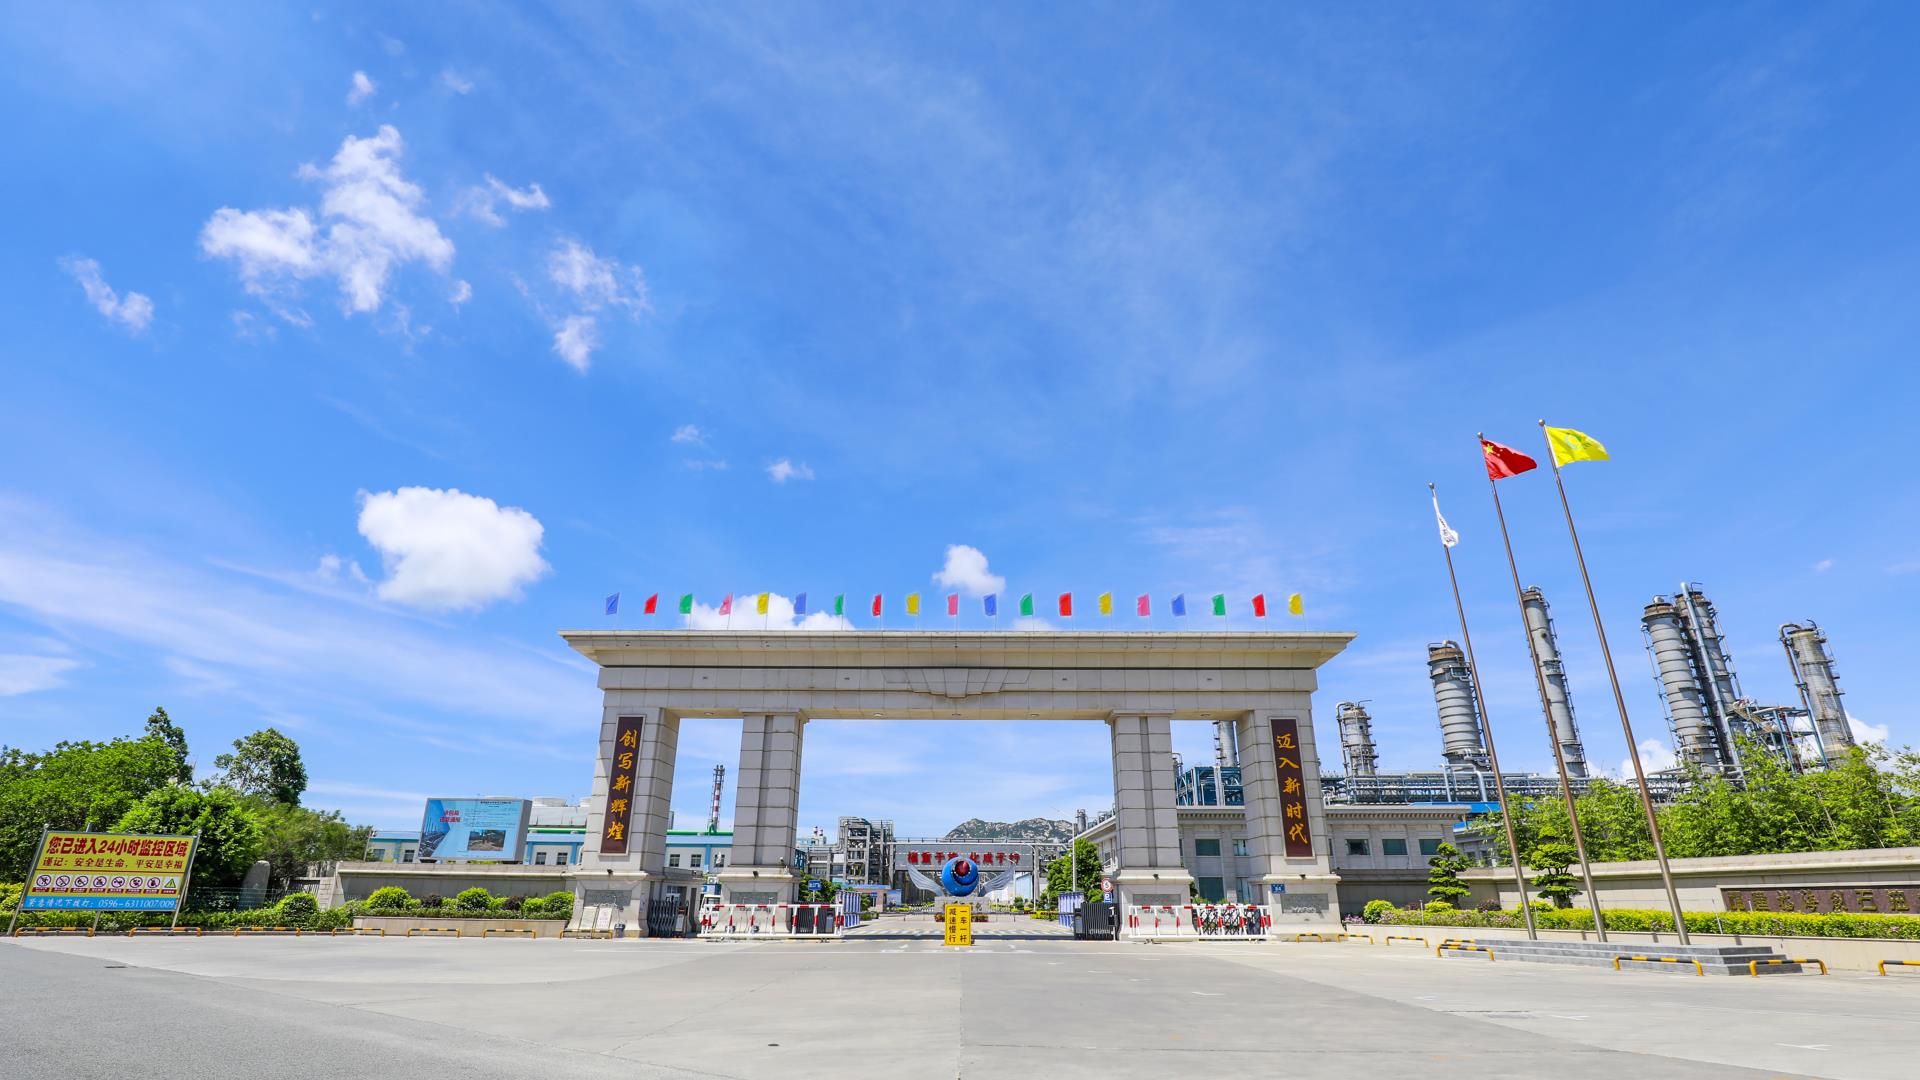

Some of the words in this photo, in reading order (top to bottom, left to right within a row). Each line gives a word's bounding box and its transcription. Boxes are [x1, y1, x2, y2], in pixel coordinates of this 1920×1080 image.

[607, 729, 638, 841] 创写新辉煌
[1276, 733, 1308, 844] 迈入新时代
[47, 836, 188, 857] 您已进入24小时监控区域
